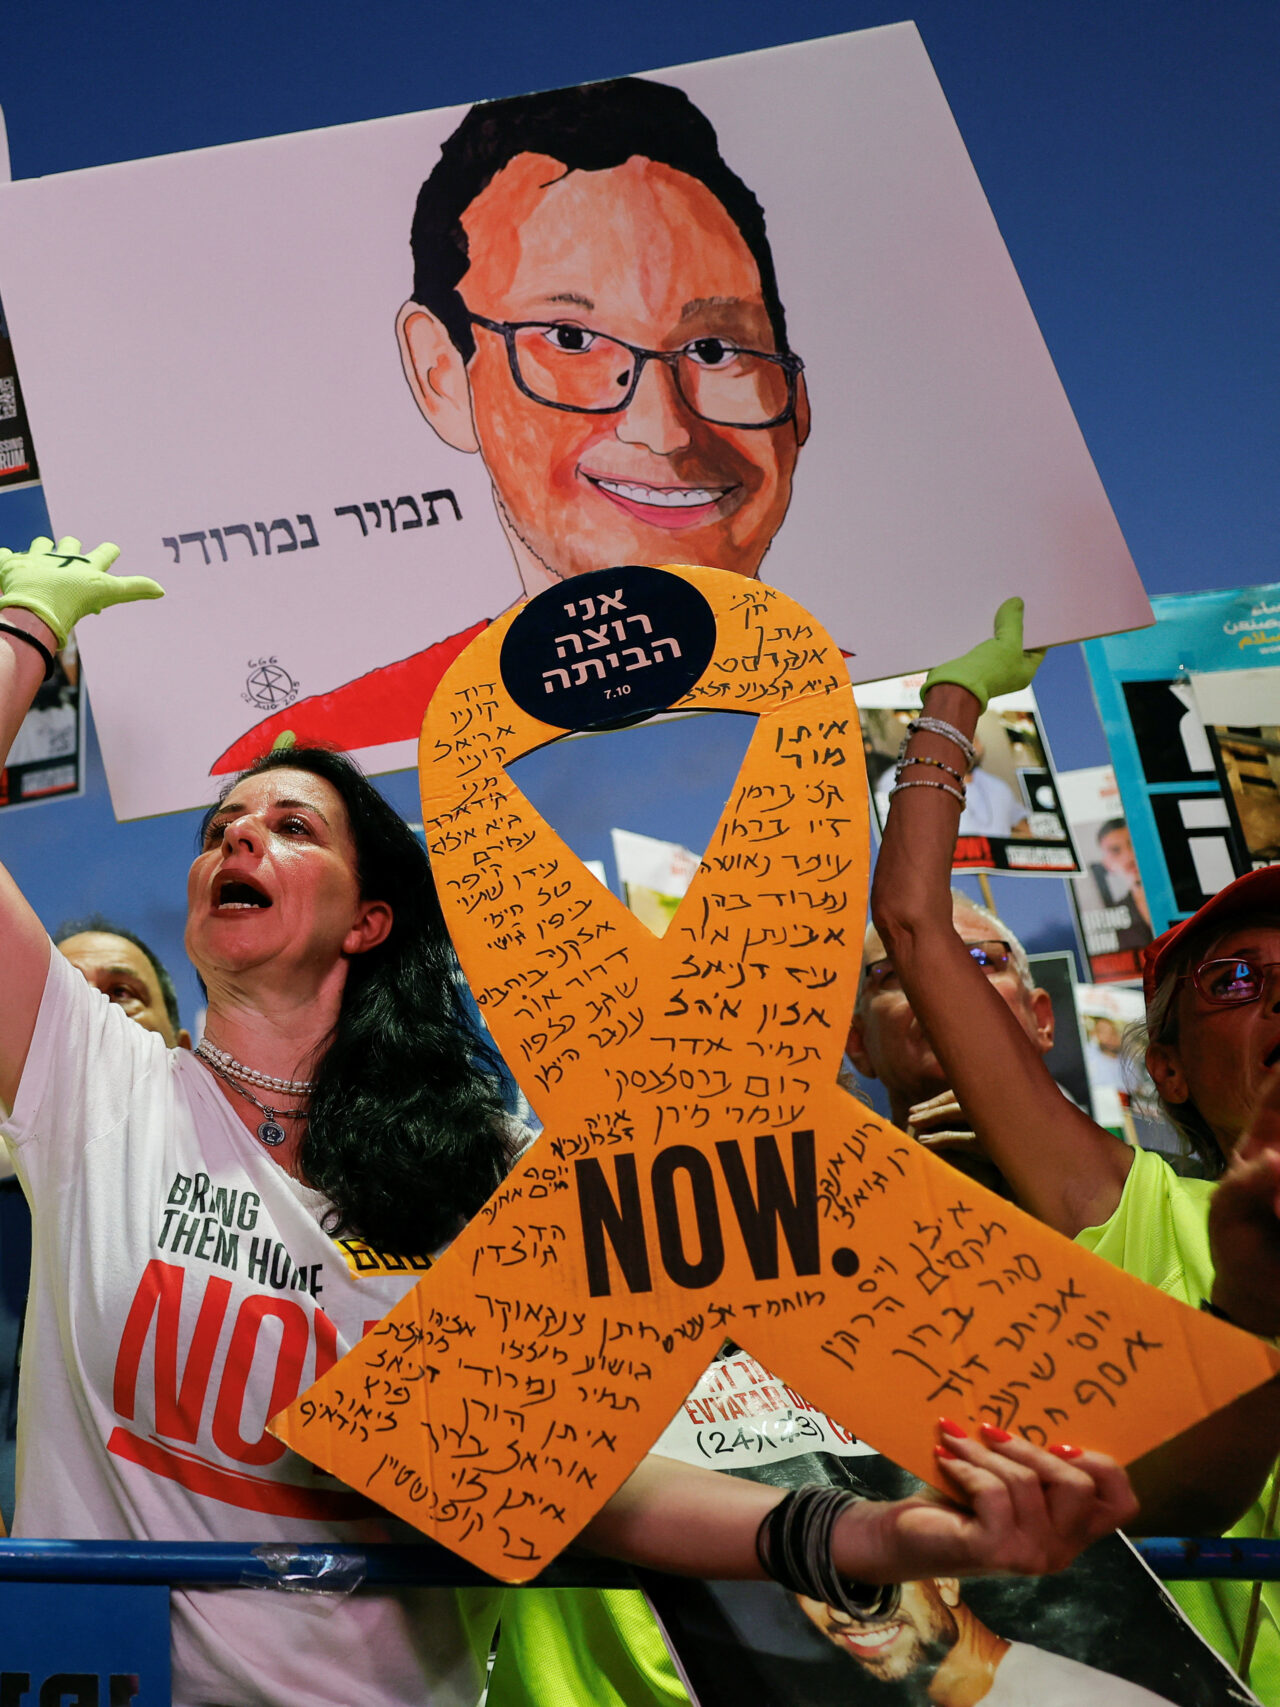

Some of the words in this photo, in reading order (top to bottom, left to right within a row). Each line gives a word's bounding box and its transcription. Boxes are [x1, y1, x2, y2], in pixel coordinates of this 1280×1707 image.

[161, 512, 321, 566] נמרודי
[335, 488, 464, 537] תמיר
[563, 588, 627, 622] אני
[554, 613, 653, 659] רוצה
[541, 636, 682, 694] הביתה
[603, 684, 632, 700] 7.10
[167, 1171, 261, 1231] BRING
[574, 1129, 860, 1297] NOW.
[157, 1208, 239, 1272] THEM
